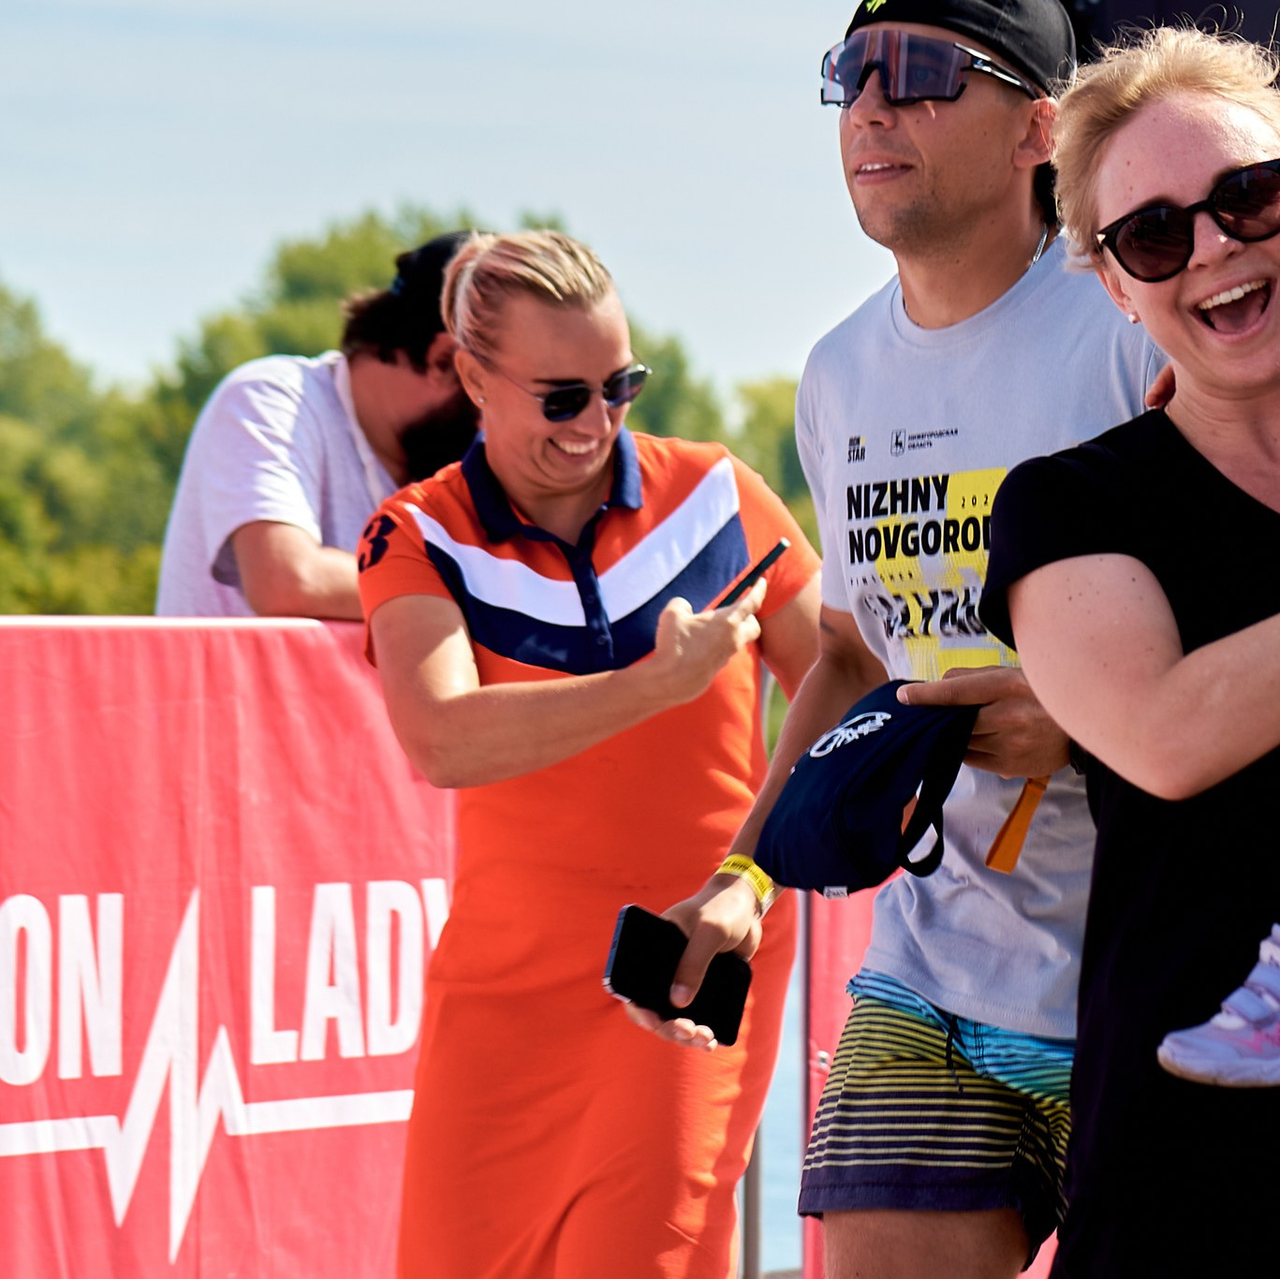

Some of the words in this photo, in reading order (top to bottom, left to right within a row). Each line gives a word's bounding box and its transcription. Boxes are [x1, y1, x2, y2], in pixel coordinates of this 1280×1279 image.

[847, 446, 866, 464] STAR
[847, 474, 950, 521] NIZHNY
[358, 514, 398, 573] 3
